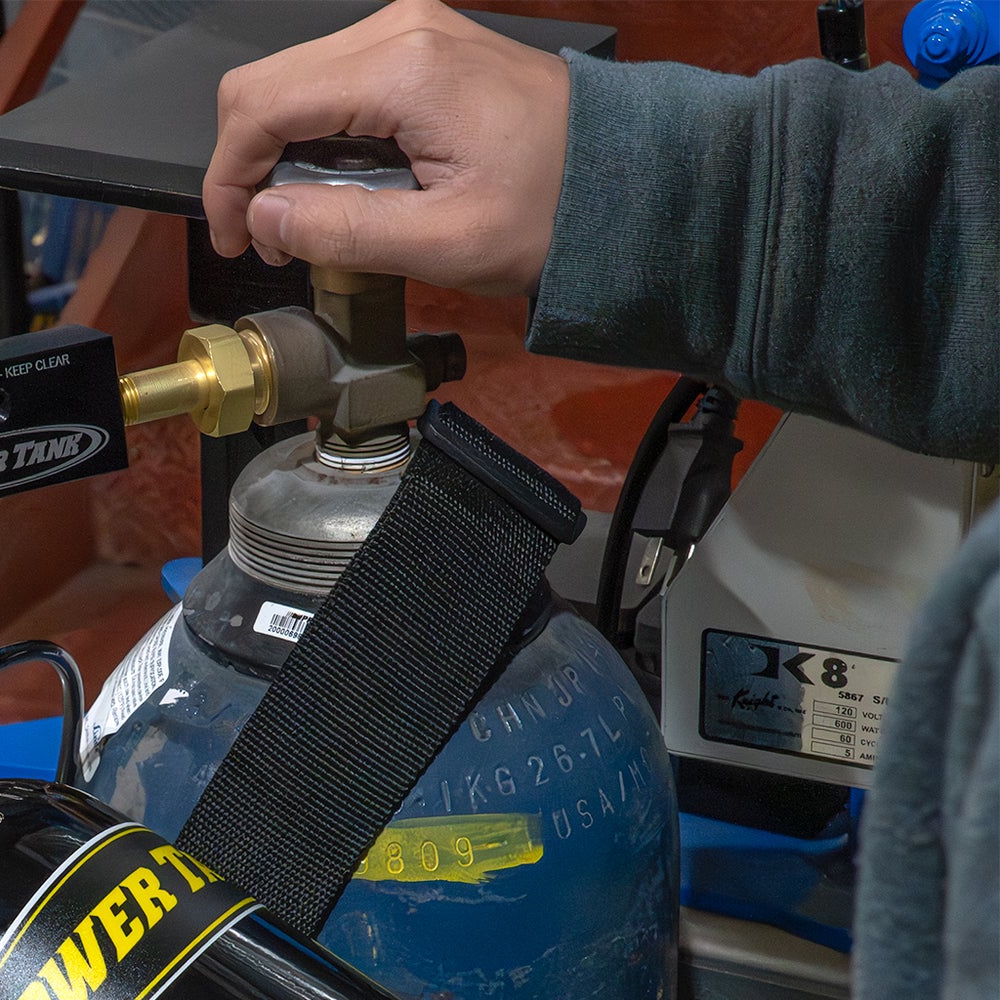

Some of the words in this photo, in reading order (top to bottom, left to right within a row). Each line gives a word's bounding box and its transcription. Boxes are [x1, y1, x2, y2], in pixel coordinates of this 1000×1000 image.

[4, 361, 34, 379] KEEP
[34, 353, 71, 371] CLEAR
[12, 432, 84, 471] TANK
[838, 690, 865, 703] 5867
[835, 706, 853, 717] 120
[834, 719, 853, 730] 600
[839, 734, 852, 744] 60
[844, 748, 852, 758] 5
